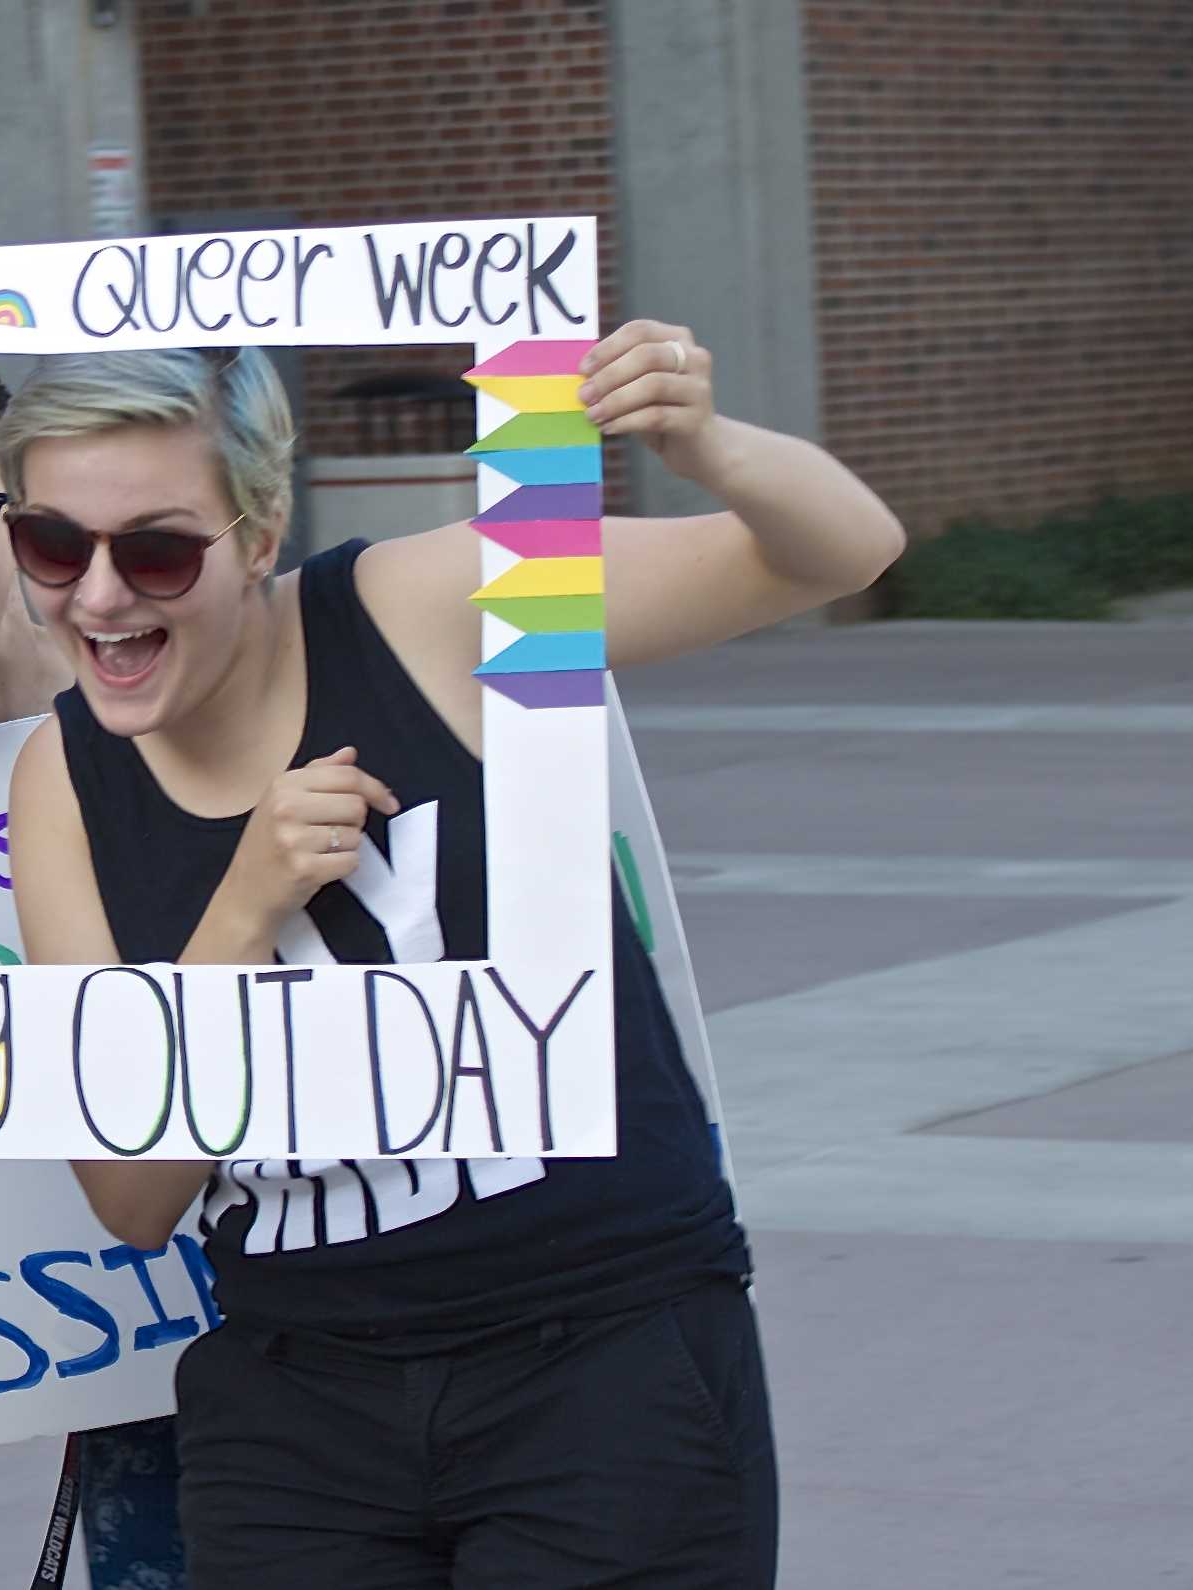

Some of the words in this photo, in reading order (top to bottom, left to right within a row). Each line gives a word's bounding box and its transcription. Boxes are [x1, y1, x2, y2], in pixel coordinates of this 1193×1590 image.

[71, 966, 314, 1157] OUT
[363, 965, 596, 1156] DAY
[41, 1514, 71, 1583] WILDCATS
